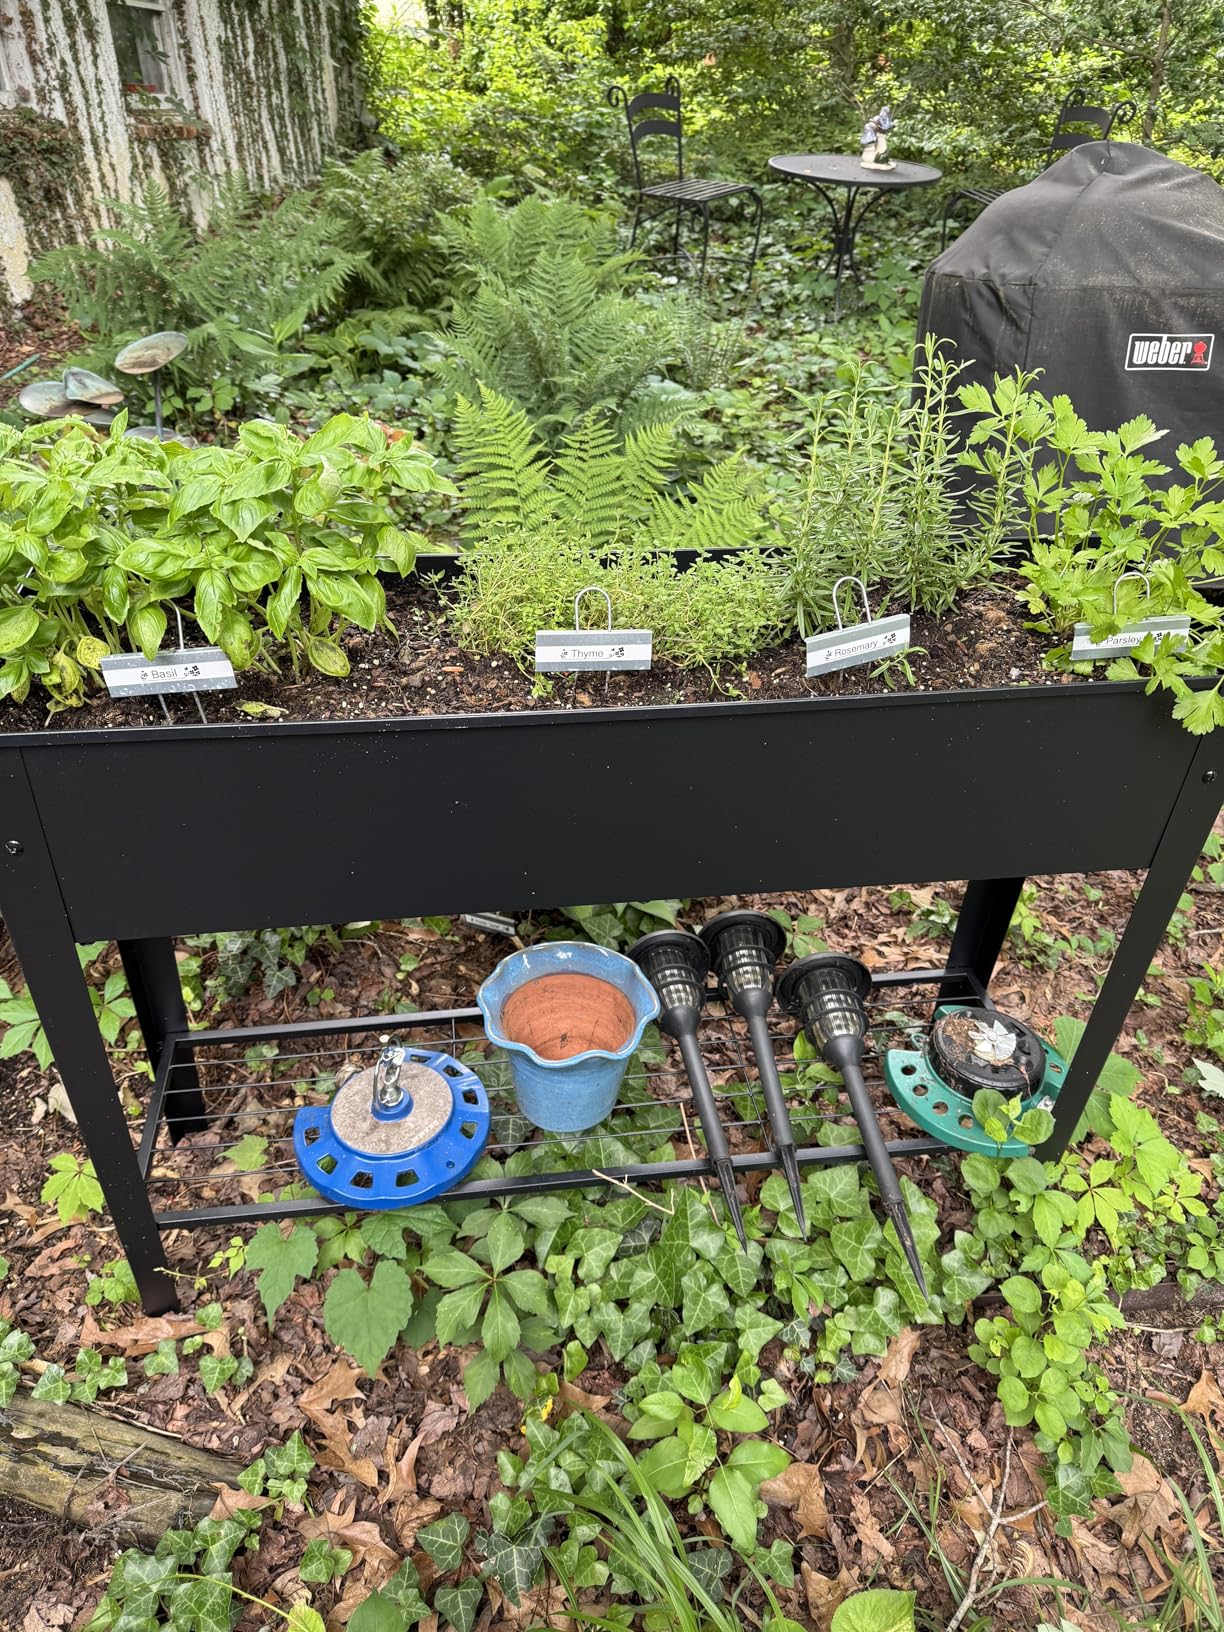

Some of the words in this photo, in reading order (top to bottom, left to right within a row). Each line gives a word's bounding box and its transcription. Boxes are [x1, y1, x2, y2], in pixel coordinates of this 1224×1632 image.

[1132, 337, 1193, 365] weber
[1106, 636, 1142, 646] Parsley
[834, 640, 878, 657] Rosemary
[572, 649, 604, 659] Thyme
[151, 669, 178, 679] Basil
